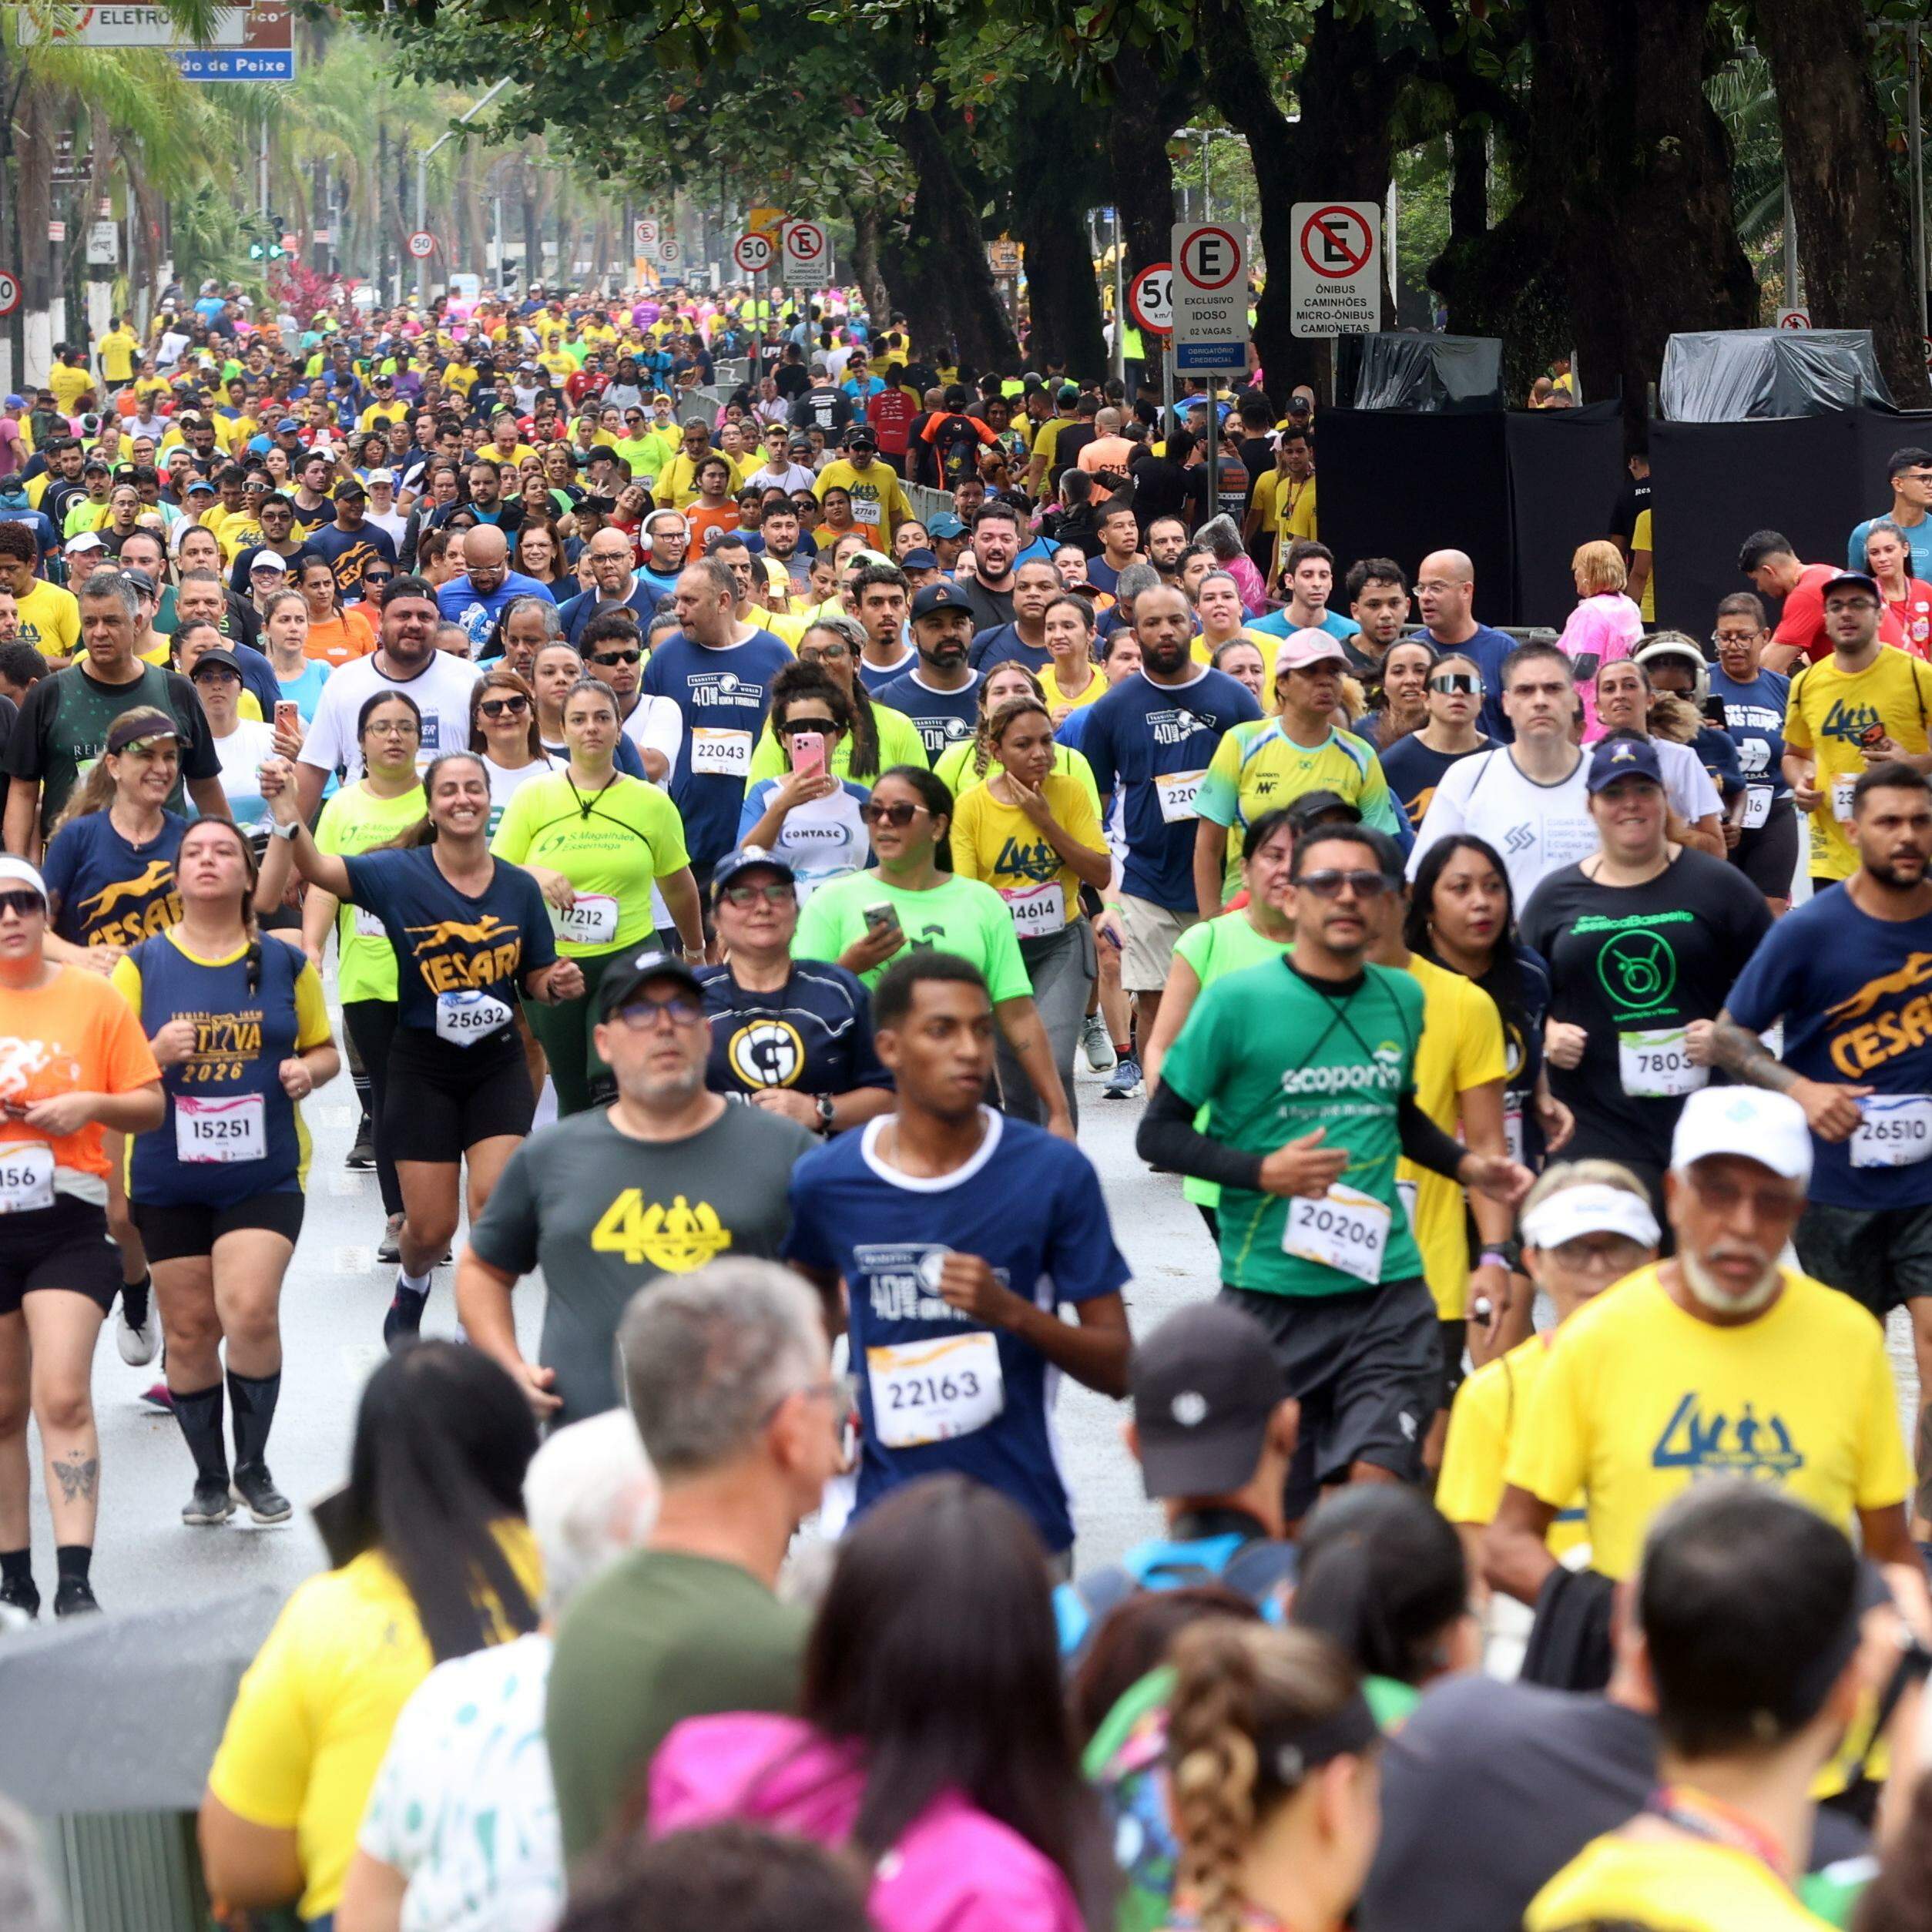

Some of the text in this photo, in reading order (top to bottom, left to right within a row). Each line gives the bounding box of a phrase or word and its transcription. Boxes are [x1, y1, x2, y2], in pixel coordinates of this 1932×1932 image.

[100, 11, 169, 25] ELETRO
[208, 59, 229, 72] de
[236, 59, 286, 72] Peixe
[414, 238, 430, 248] 50
[742, 241, 766, 258] 50
[1199, 240, 1220, 267] E
[0, 281, 12, 298] 0
[1315, 283, 1356, 293] ÔNIBUS
[1184, 297, 1234, 305] EXCLUSIVO
[1304, 297, 1367, 307] CAMINHÕES
[1192, 310, 1227, 320] IDOSO
[1296, 310, 1375, 320] MICRO-ÔNIBUS
[1301, 324, 1370, 333] CAMIONETAS
[855, 508, 877, 516] 27749
[693, 686, 709, 707] 40
[1154, 723, 1172, 744] 40
[698, 744, 744, 760] 22043
[785, 830, 840, 839] CONTASC
[561, 908, 602, 926] 17212
[1009, 899, 1055, 921] 14614
[447, 1008, 505, 1028] 25632
[181, 1062, 243, 1083] 2026
[193, 1119, 250, 1139] 15251
[1862, 1119, 1927, 1141] 26510
[1300, 1206, 1377, 1249] 20206
[888, 1370, 981, 1410] 22163
